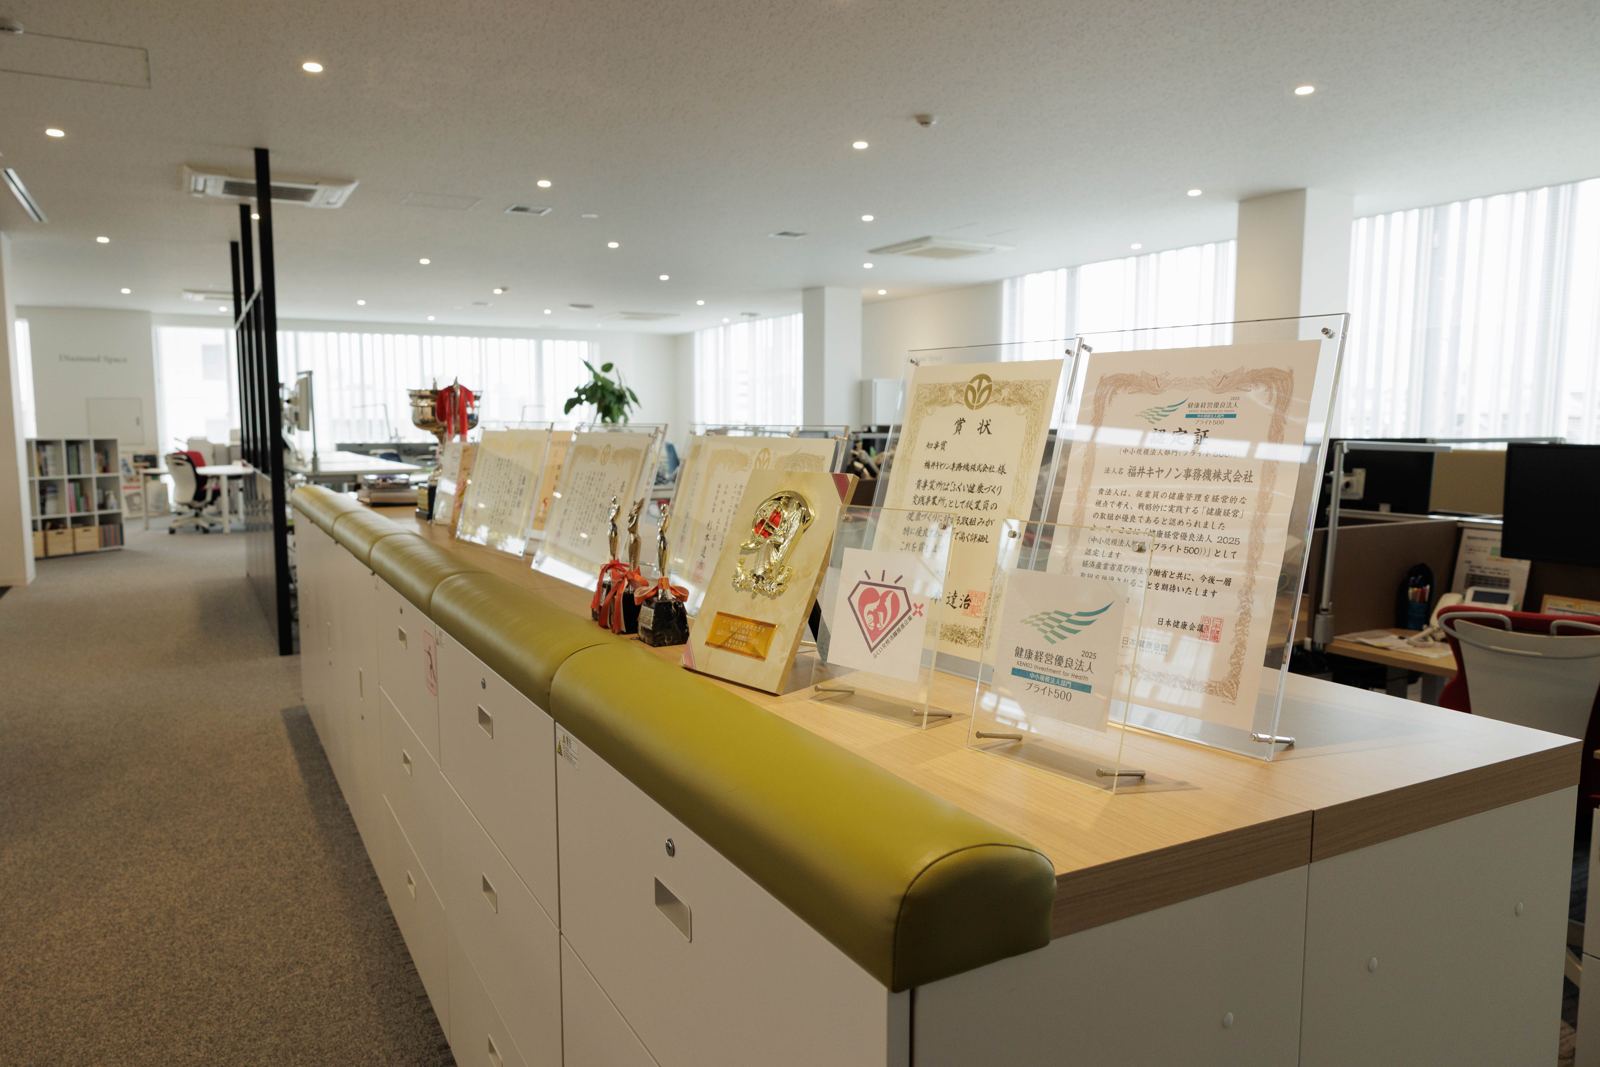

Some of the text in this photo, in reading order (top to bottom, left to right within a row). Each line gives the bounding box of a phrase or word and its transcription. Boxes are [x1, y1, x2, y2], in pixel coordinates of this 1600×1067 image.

[1216, 536, 1241, 546] 2025
[1014, 645, 1095, 675] 健康経営優良法人
[1081, 650, 1097, 660] 2025
[1025, 682, 1073, 702] ブライト500
